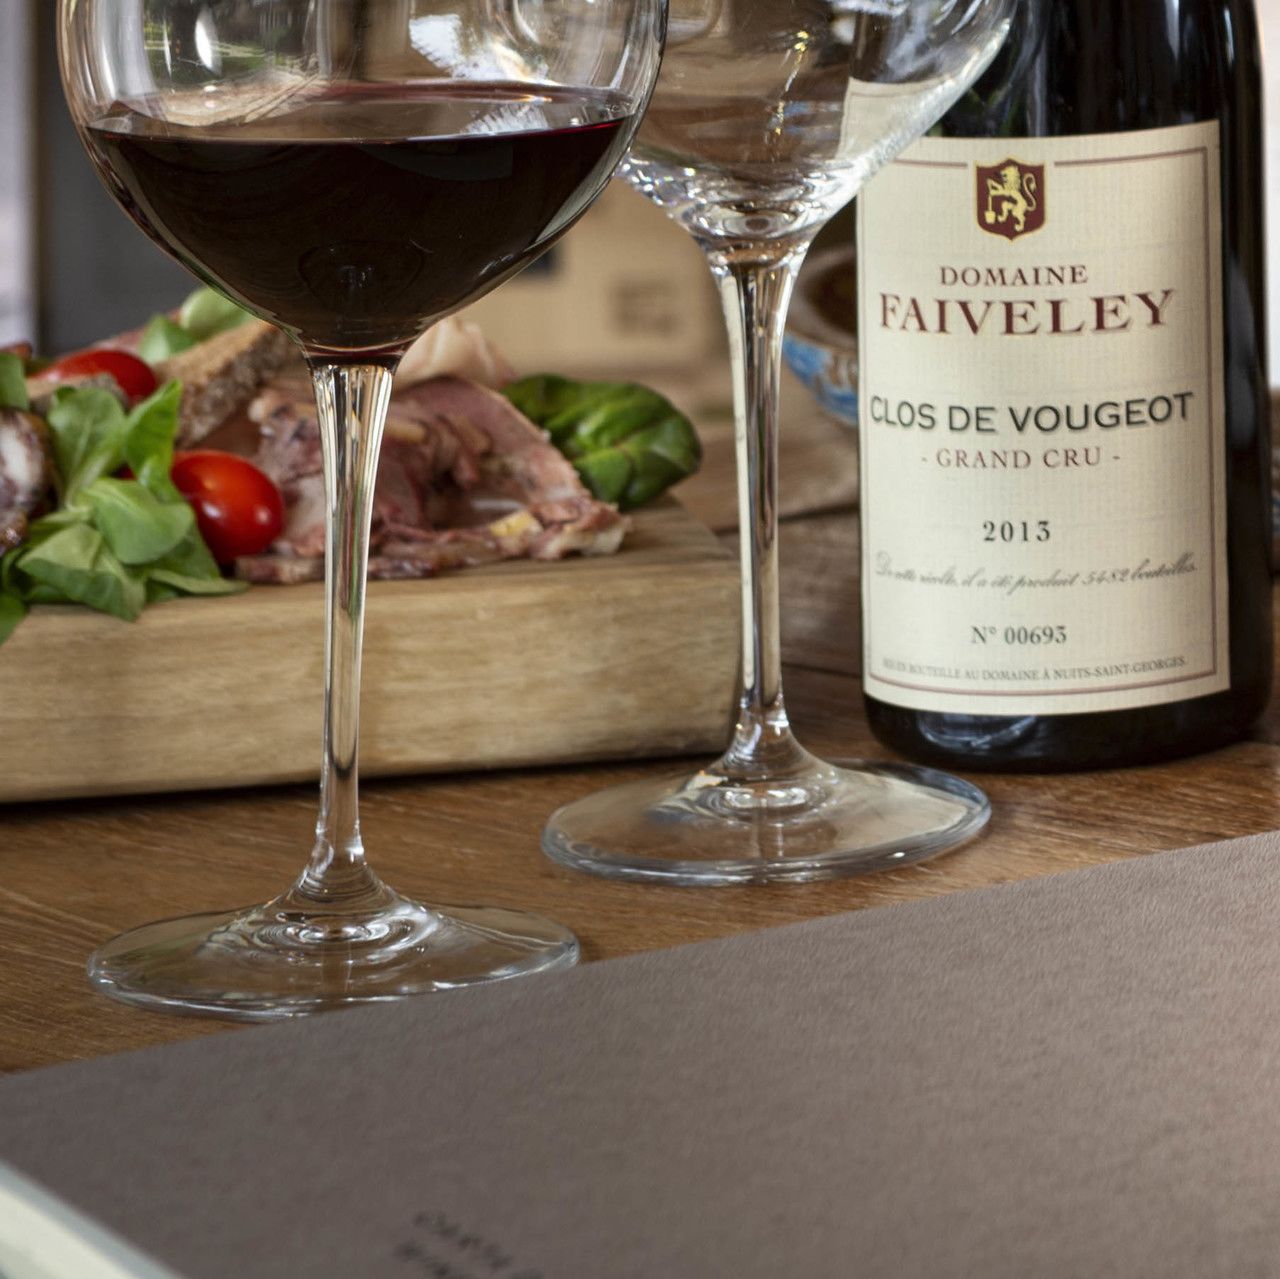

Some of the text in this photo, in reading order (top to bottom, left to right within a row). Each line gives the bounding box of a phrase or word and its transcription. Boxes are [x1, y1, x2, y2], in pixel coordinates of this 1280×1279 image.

[940, 265, 1088, 287] DOMAINE
[879, 288, 1175, 336] FAIVELEY
[870, 391, 1194, 432] CLOS DE VOUGEOT
[936, 448, 1031, 469] GRAND
[1043, 446, 1103, 468] CRU
[983, 520, 1051, 542] 2013
